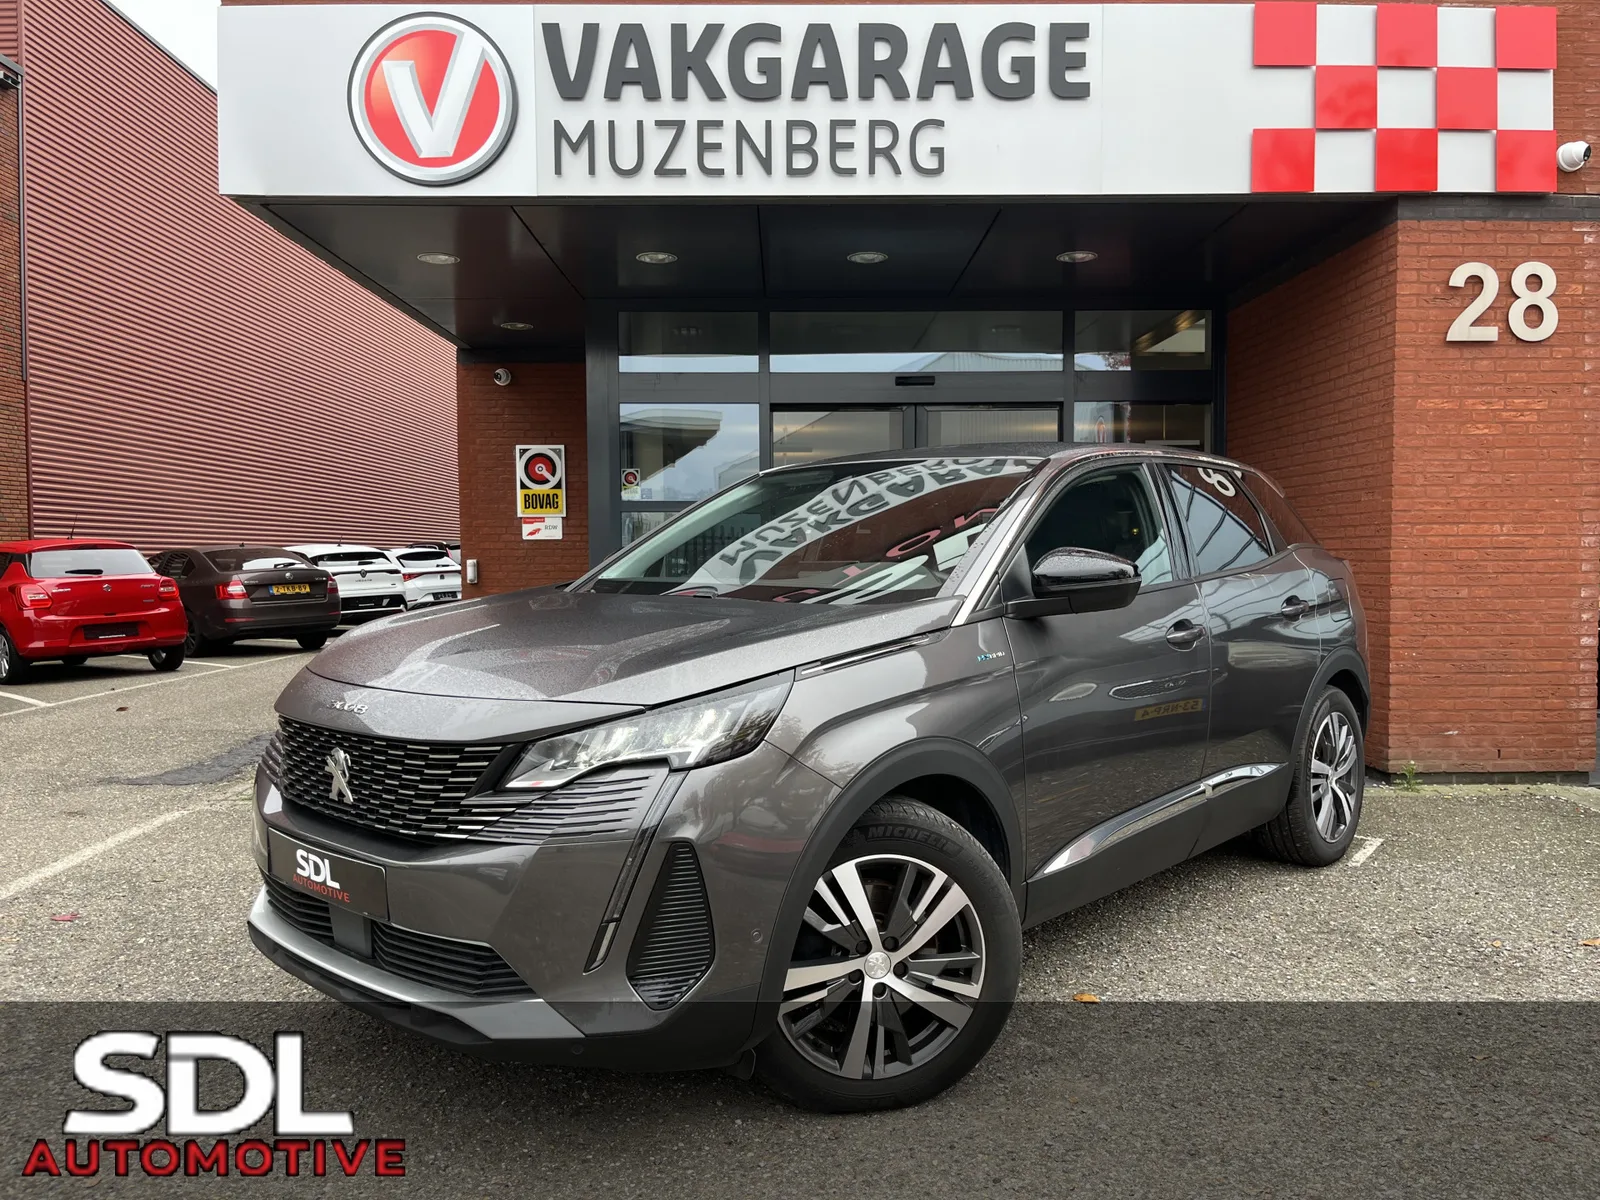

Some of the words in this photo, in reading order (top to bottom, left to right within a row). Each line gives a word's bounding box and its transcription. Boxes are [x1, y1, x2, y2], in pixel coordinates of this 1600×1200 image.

[541, 21, 1091, 102] VAKGARAGE
[553, 118, 946, 177] MUZENBERG
[1446, 261, 1559, 342] 28
[523, 493, 559, 510] BOVAG
[292, 872, 351, 903] AUTOMOTIVE
[295, 848, 341, 890] SDL
